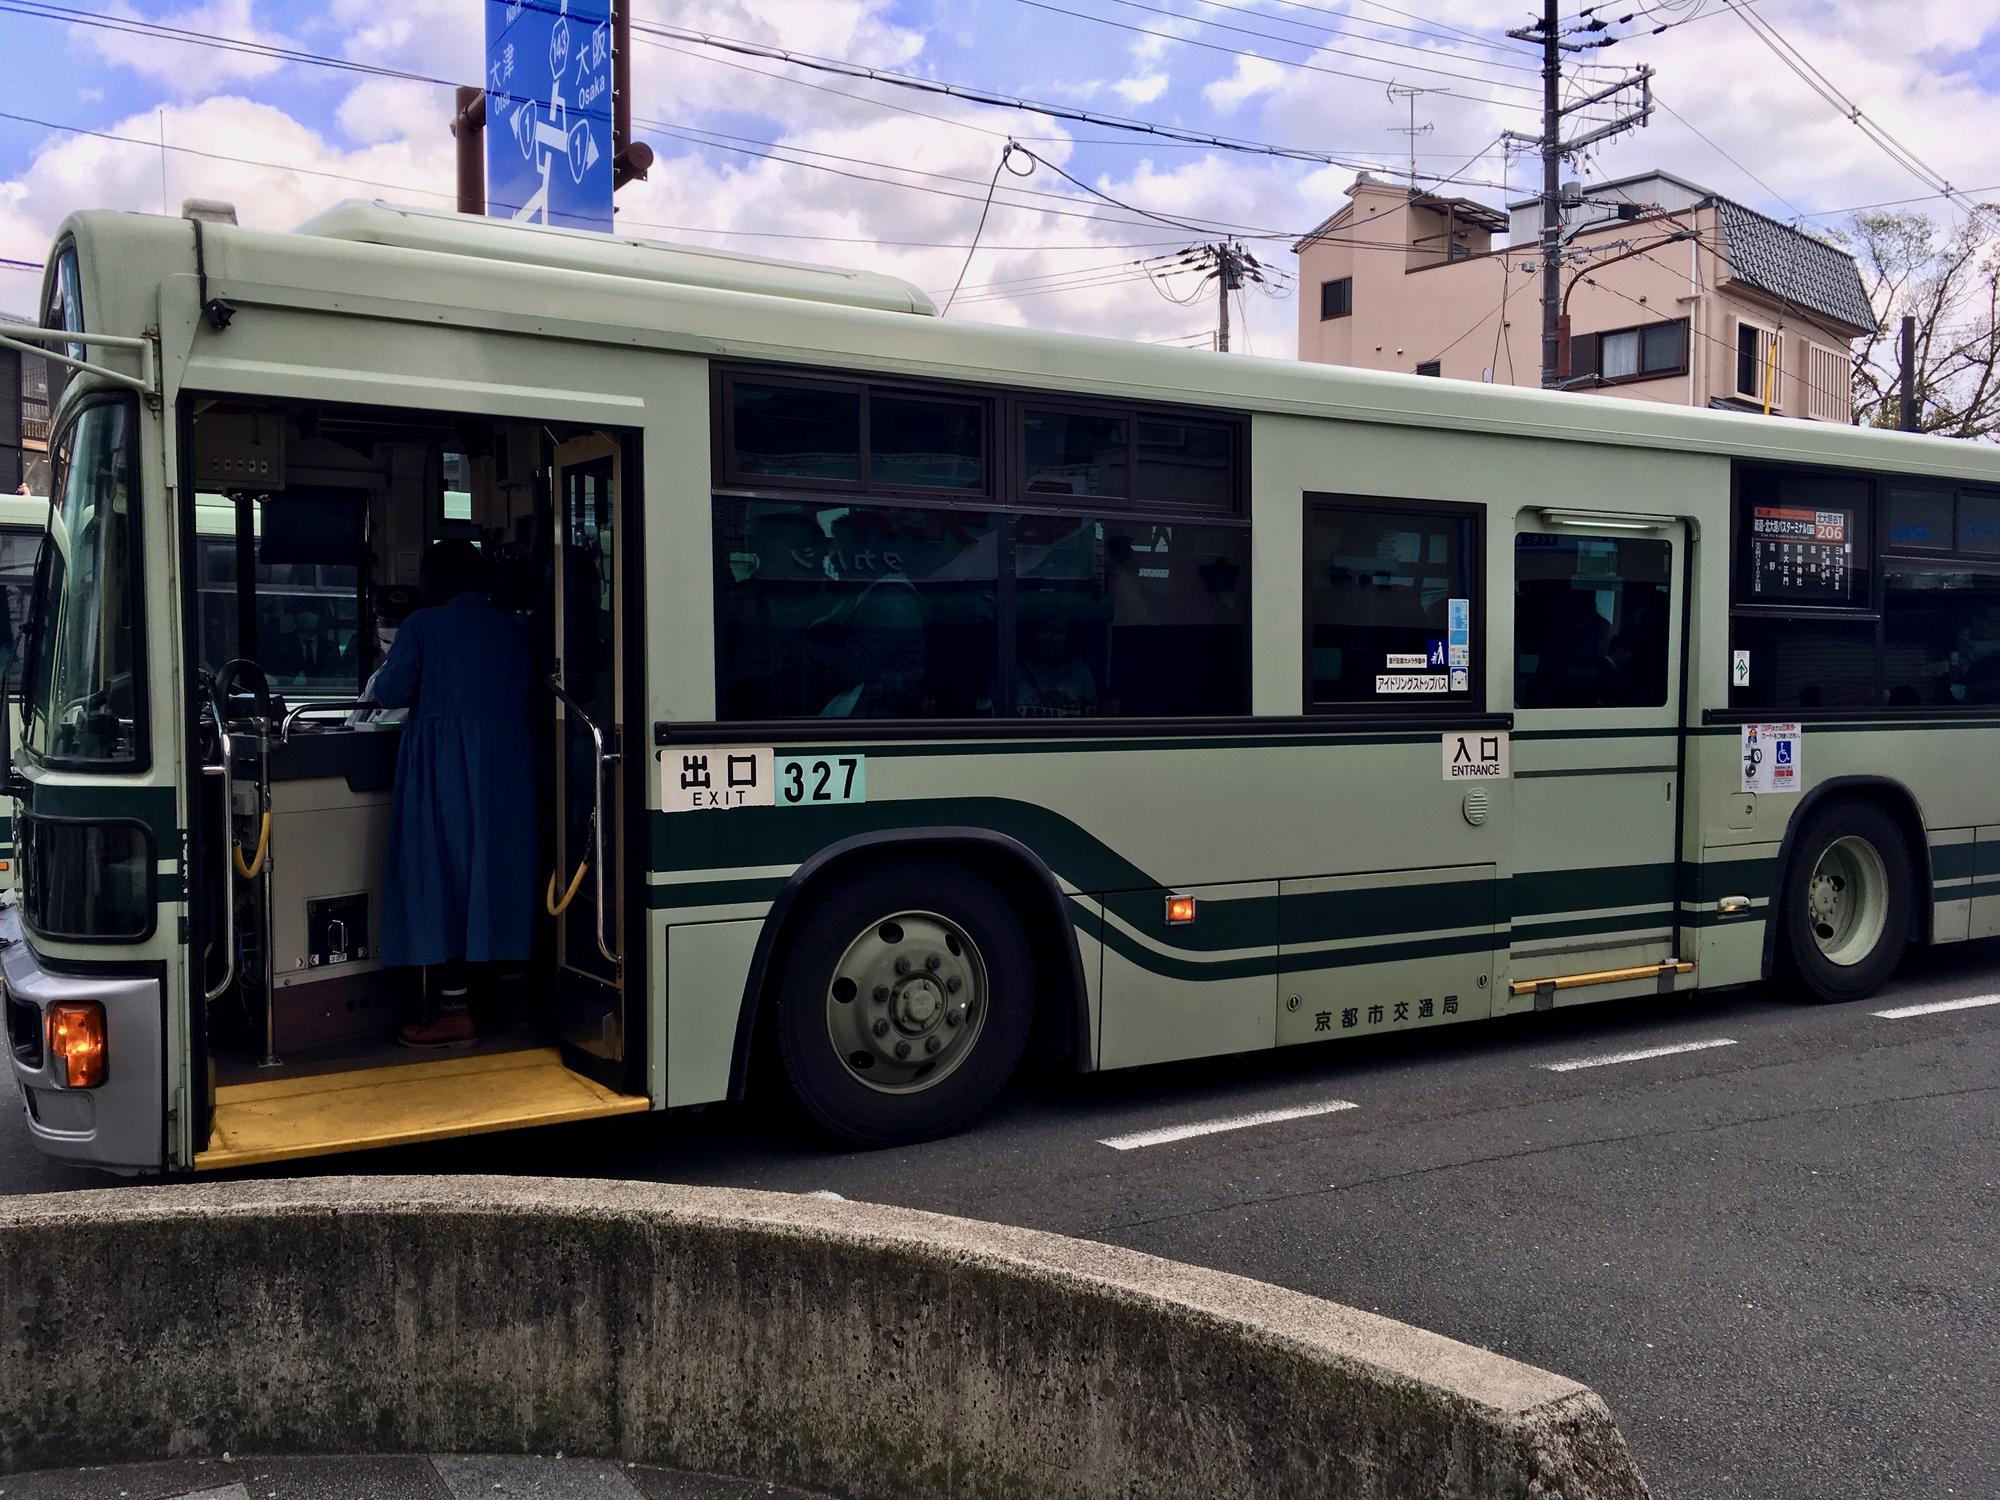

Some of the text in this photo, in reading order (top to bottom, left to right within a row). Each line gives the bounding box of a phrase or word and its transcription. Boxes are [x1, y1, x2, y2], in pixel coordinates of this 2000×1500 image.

[552, 29, 567, 64] 143
[576, 21, 606, 85] 大阪
[490, 44, 514, 95] 大津
[578, 75, 605, 109] Osaka
[1817, 525, 1842, 539] 206
[1377, 676, 1448, 691] アイドリングストップバス
[1453, 736, 1499, 763] 入口
[680, 753, 757, 790] 出口
[784, 758, 858, 804] 327
[1452, 764, 1500, 776] ENTRANCE
[692, 790, 746, 806] EXIT
[1314, 995, 1459, 1032] 京都市交通局
